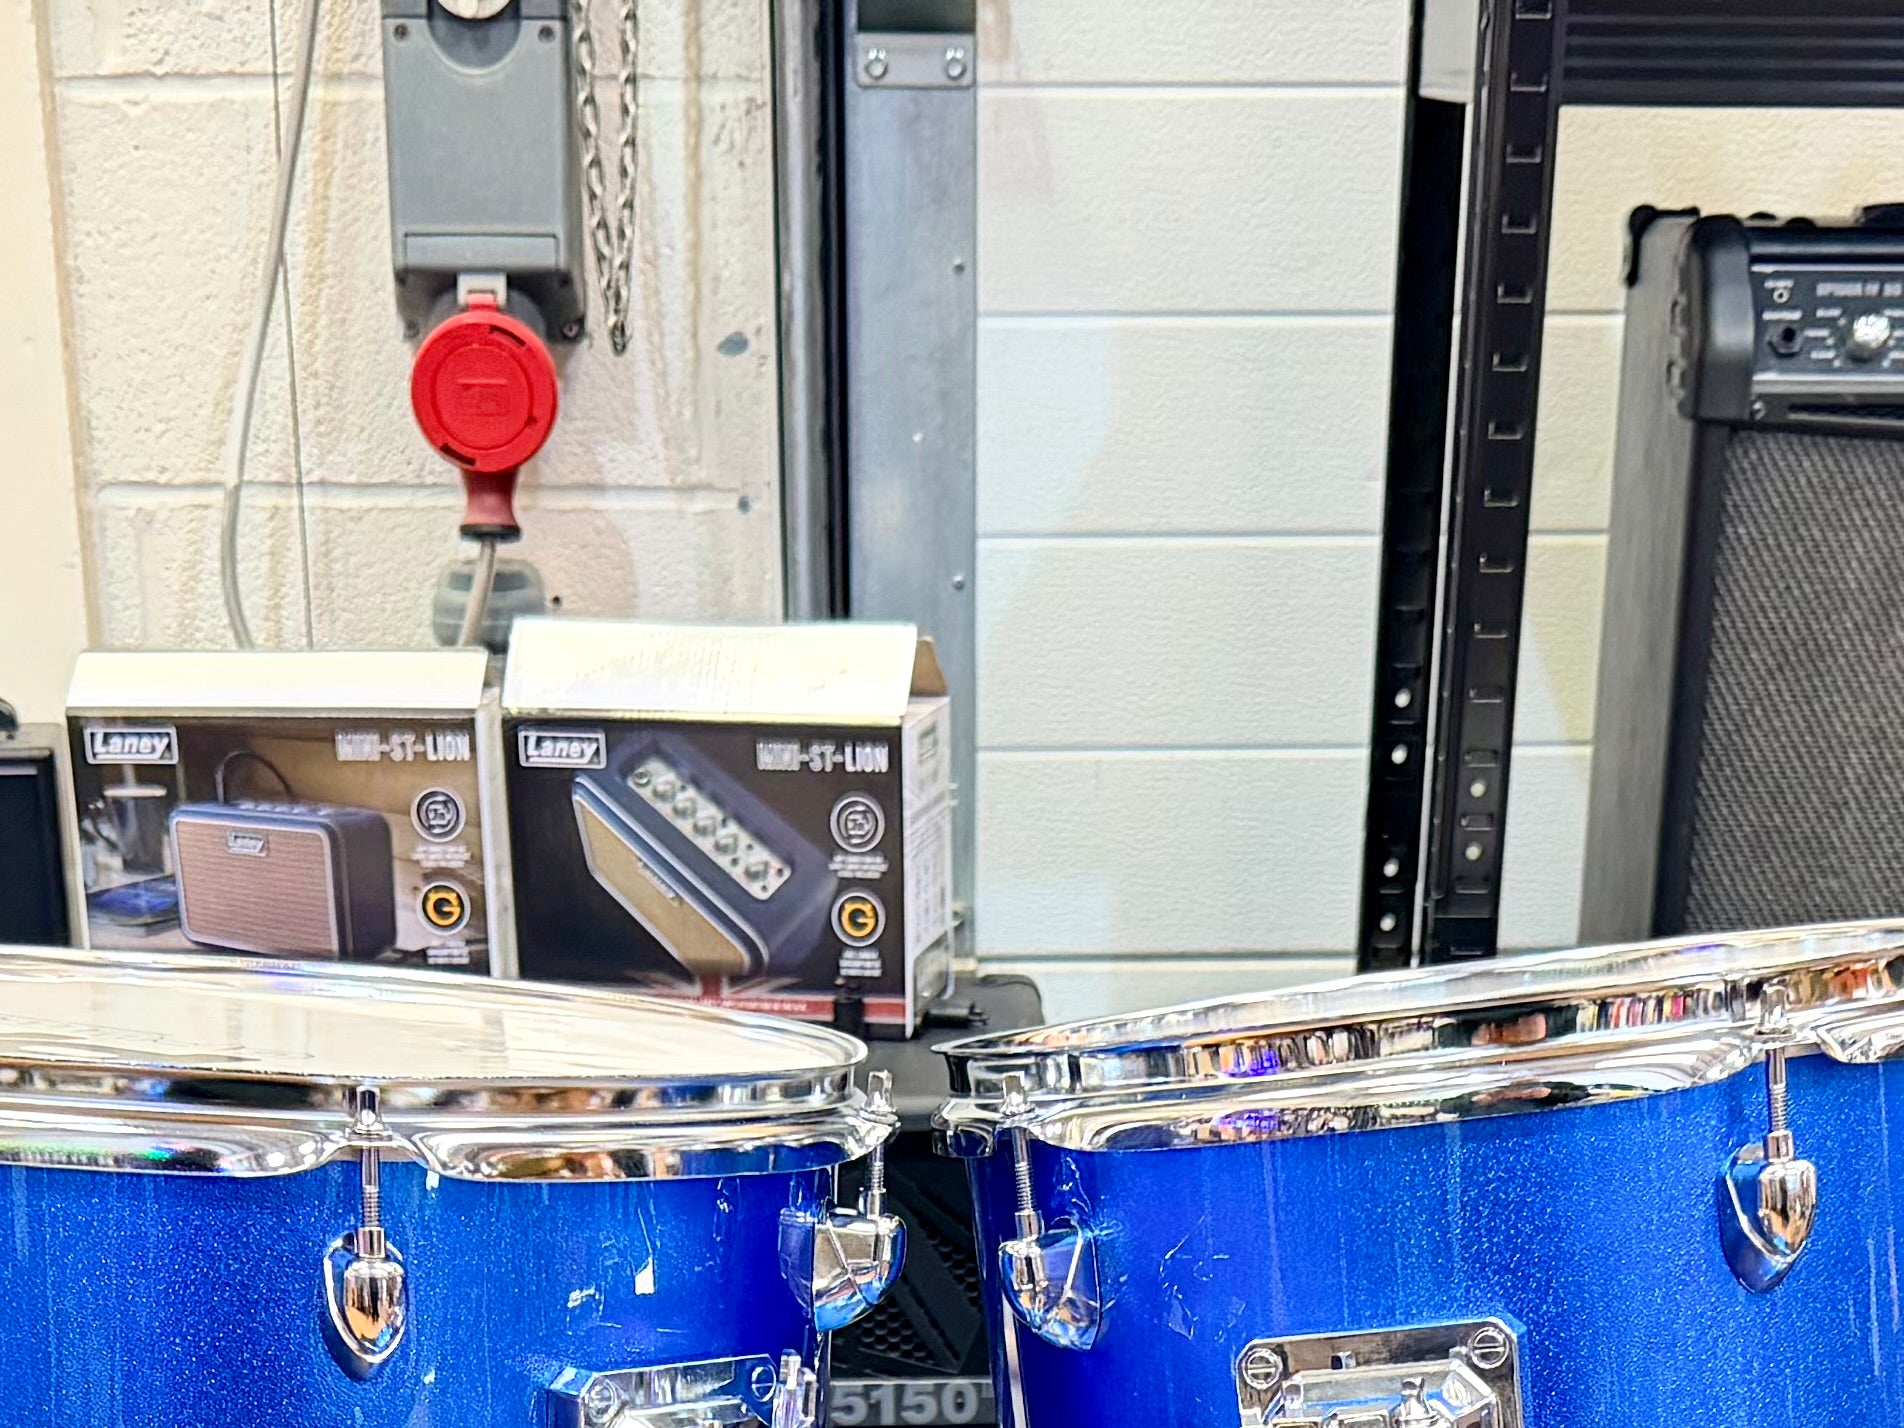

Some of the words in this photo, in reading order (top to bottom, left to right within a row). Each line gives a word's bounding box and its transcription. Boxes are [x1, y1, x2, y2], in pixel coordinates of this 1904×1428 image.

[93, 731, 169, 760] Laney
[526, 735, 599, 763] Laney
[831, 1383, 978, 1426] 5150
